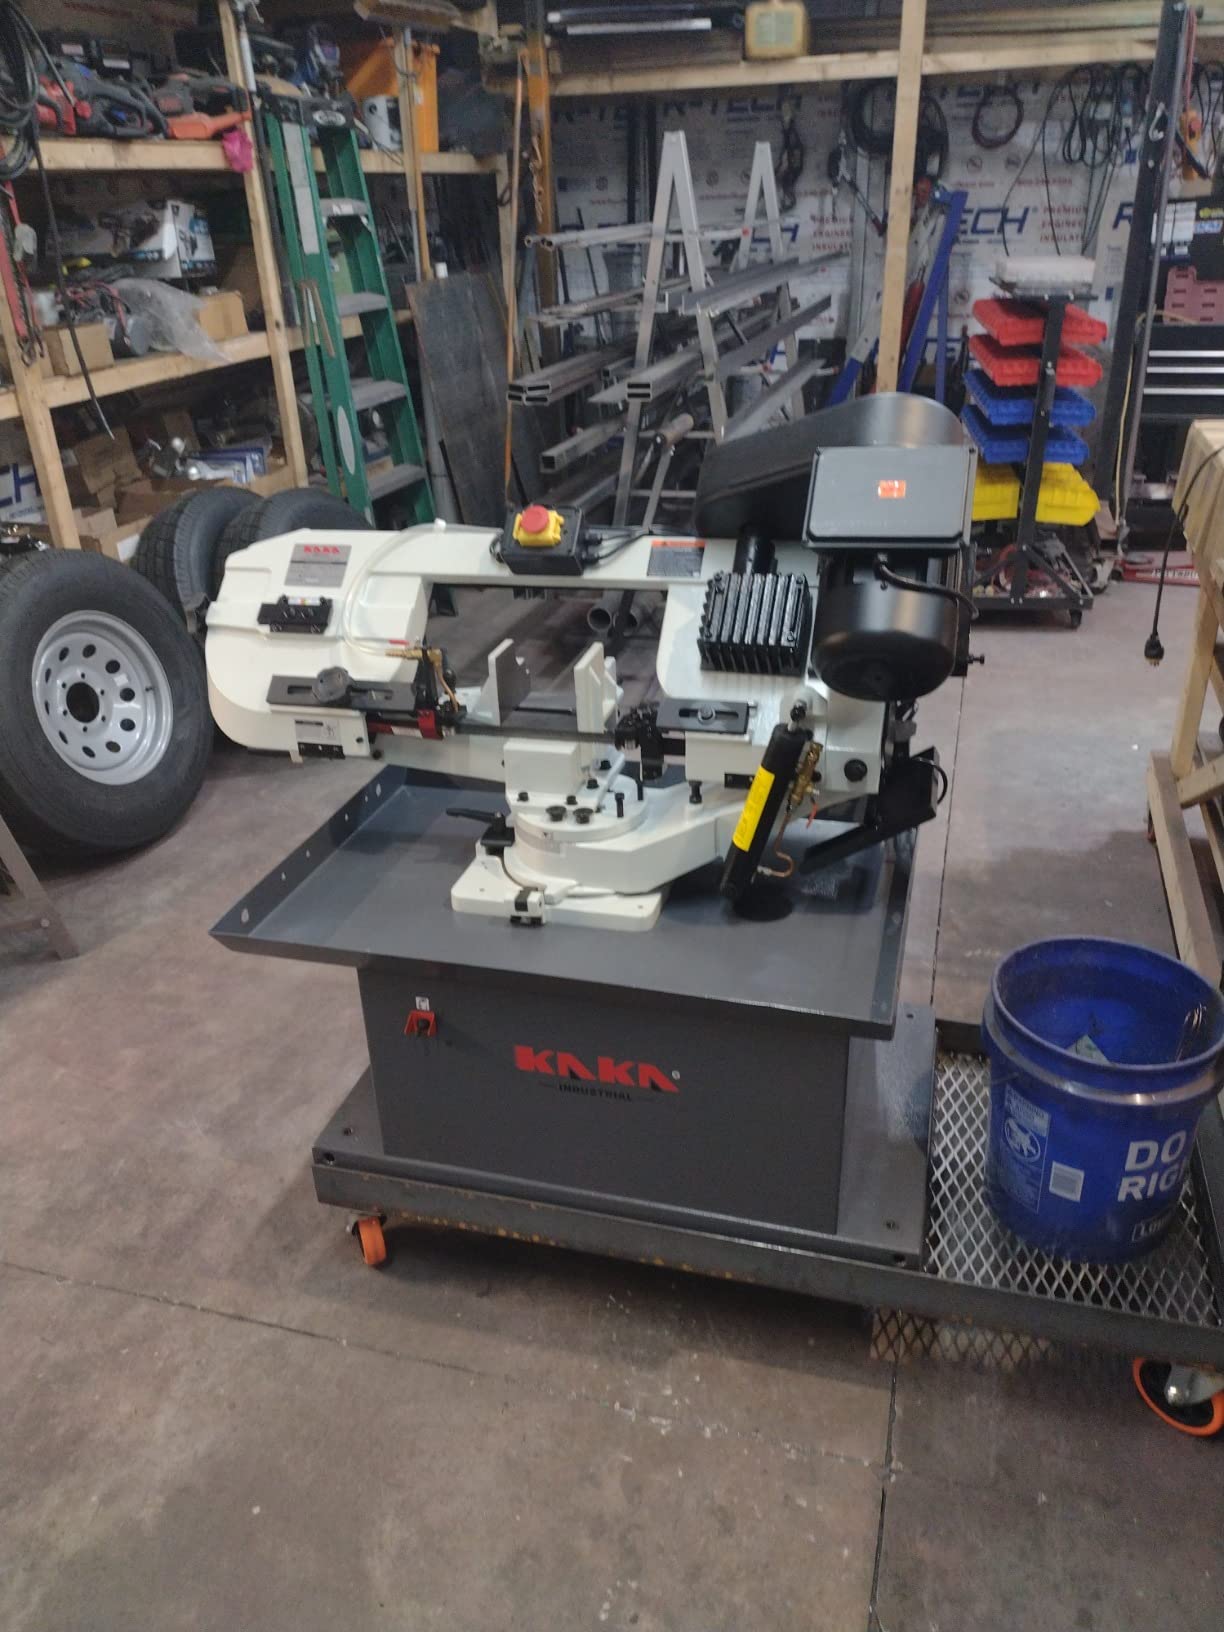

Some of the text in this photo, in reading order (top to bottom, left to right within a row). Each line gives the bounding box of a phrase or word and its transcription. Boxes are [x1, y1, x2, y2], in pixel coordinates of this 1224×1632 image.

[303, 544, 340, 555] KAKA
[513, 1044, 680, 1093] KAKA
[559, 1083, 632, 1101] INDUSTRIAL
[1124, 1130, 1187, 1172] DO
